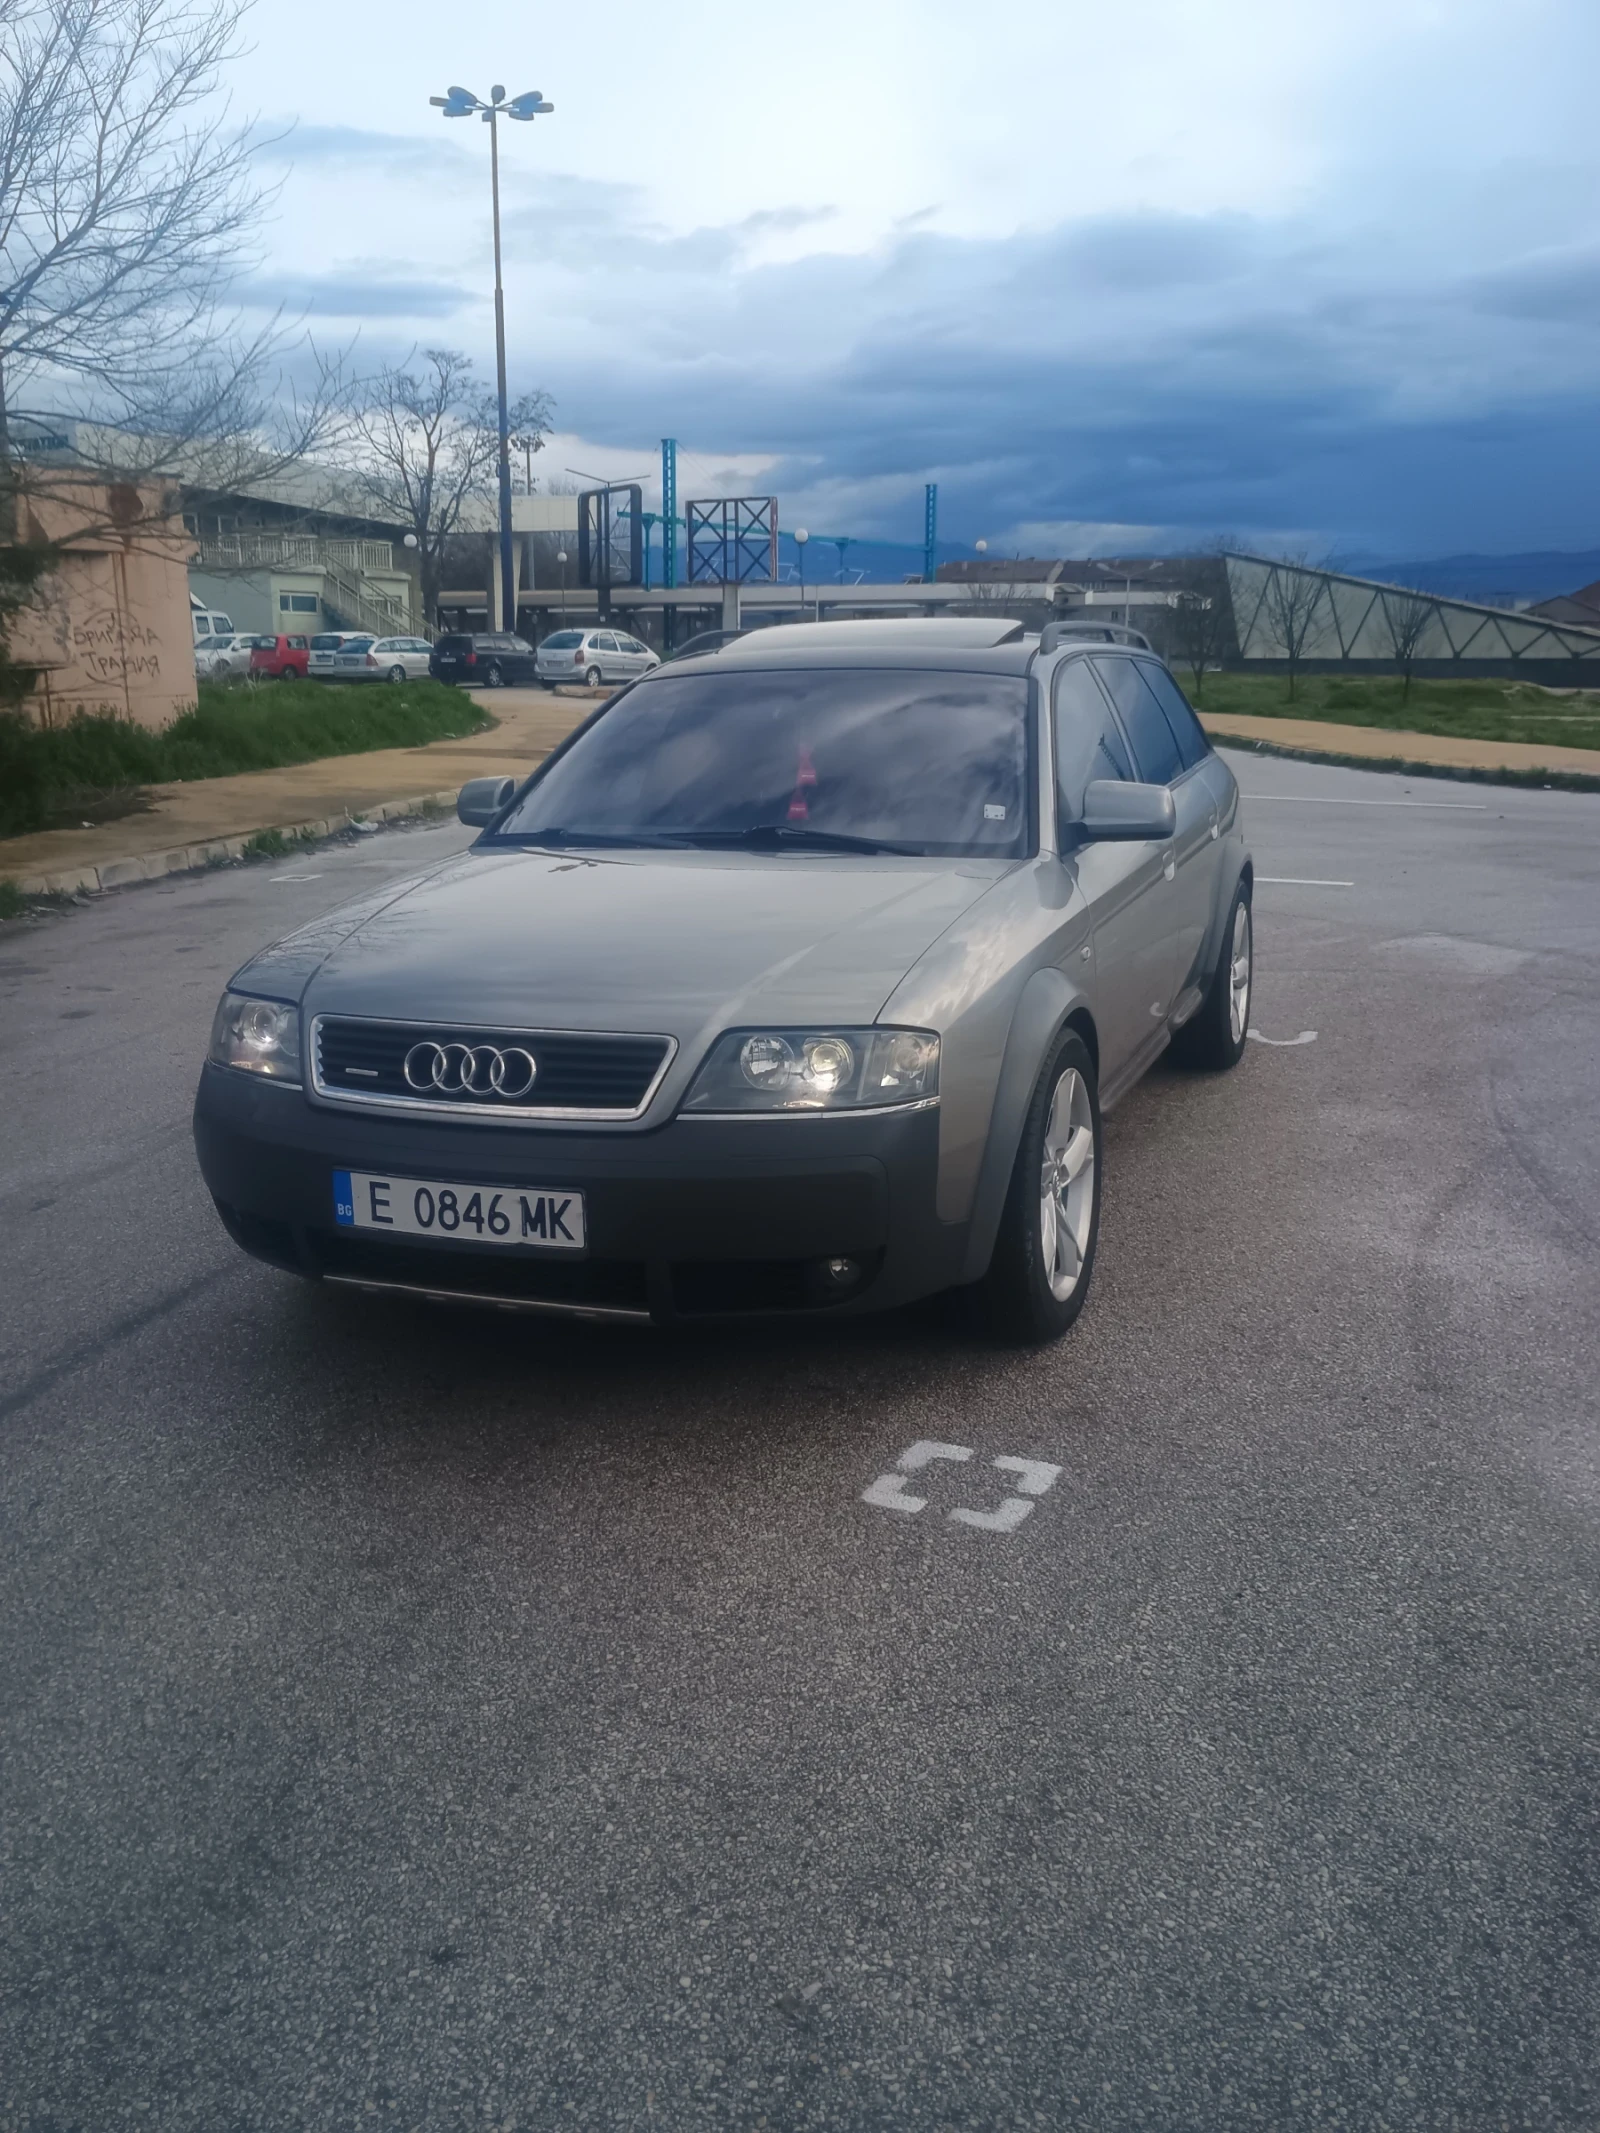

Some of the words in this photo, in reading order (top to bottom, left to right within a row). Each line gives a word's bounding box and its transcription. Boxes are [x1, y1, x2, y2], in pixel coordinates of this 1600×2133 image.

[337, 1203, 352, 1217] BG
[369, 1181, 394, 1224] E
[413, 1187, 510, 1236] 0846
[519, 1196, 575, 1241] MK
